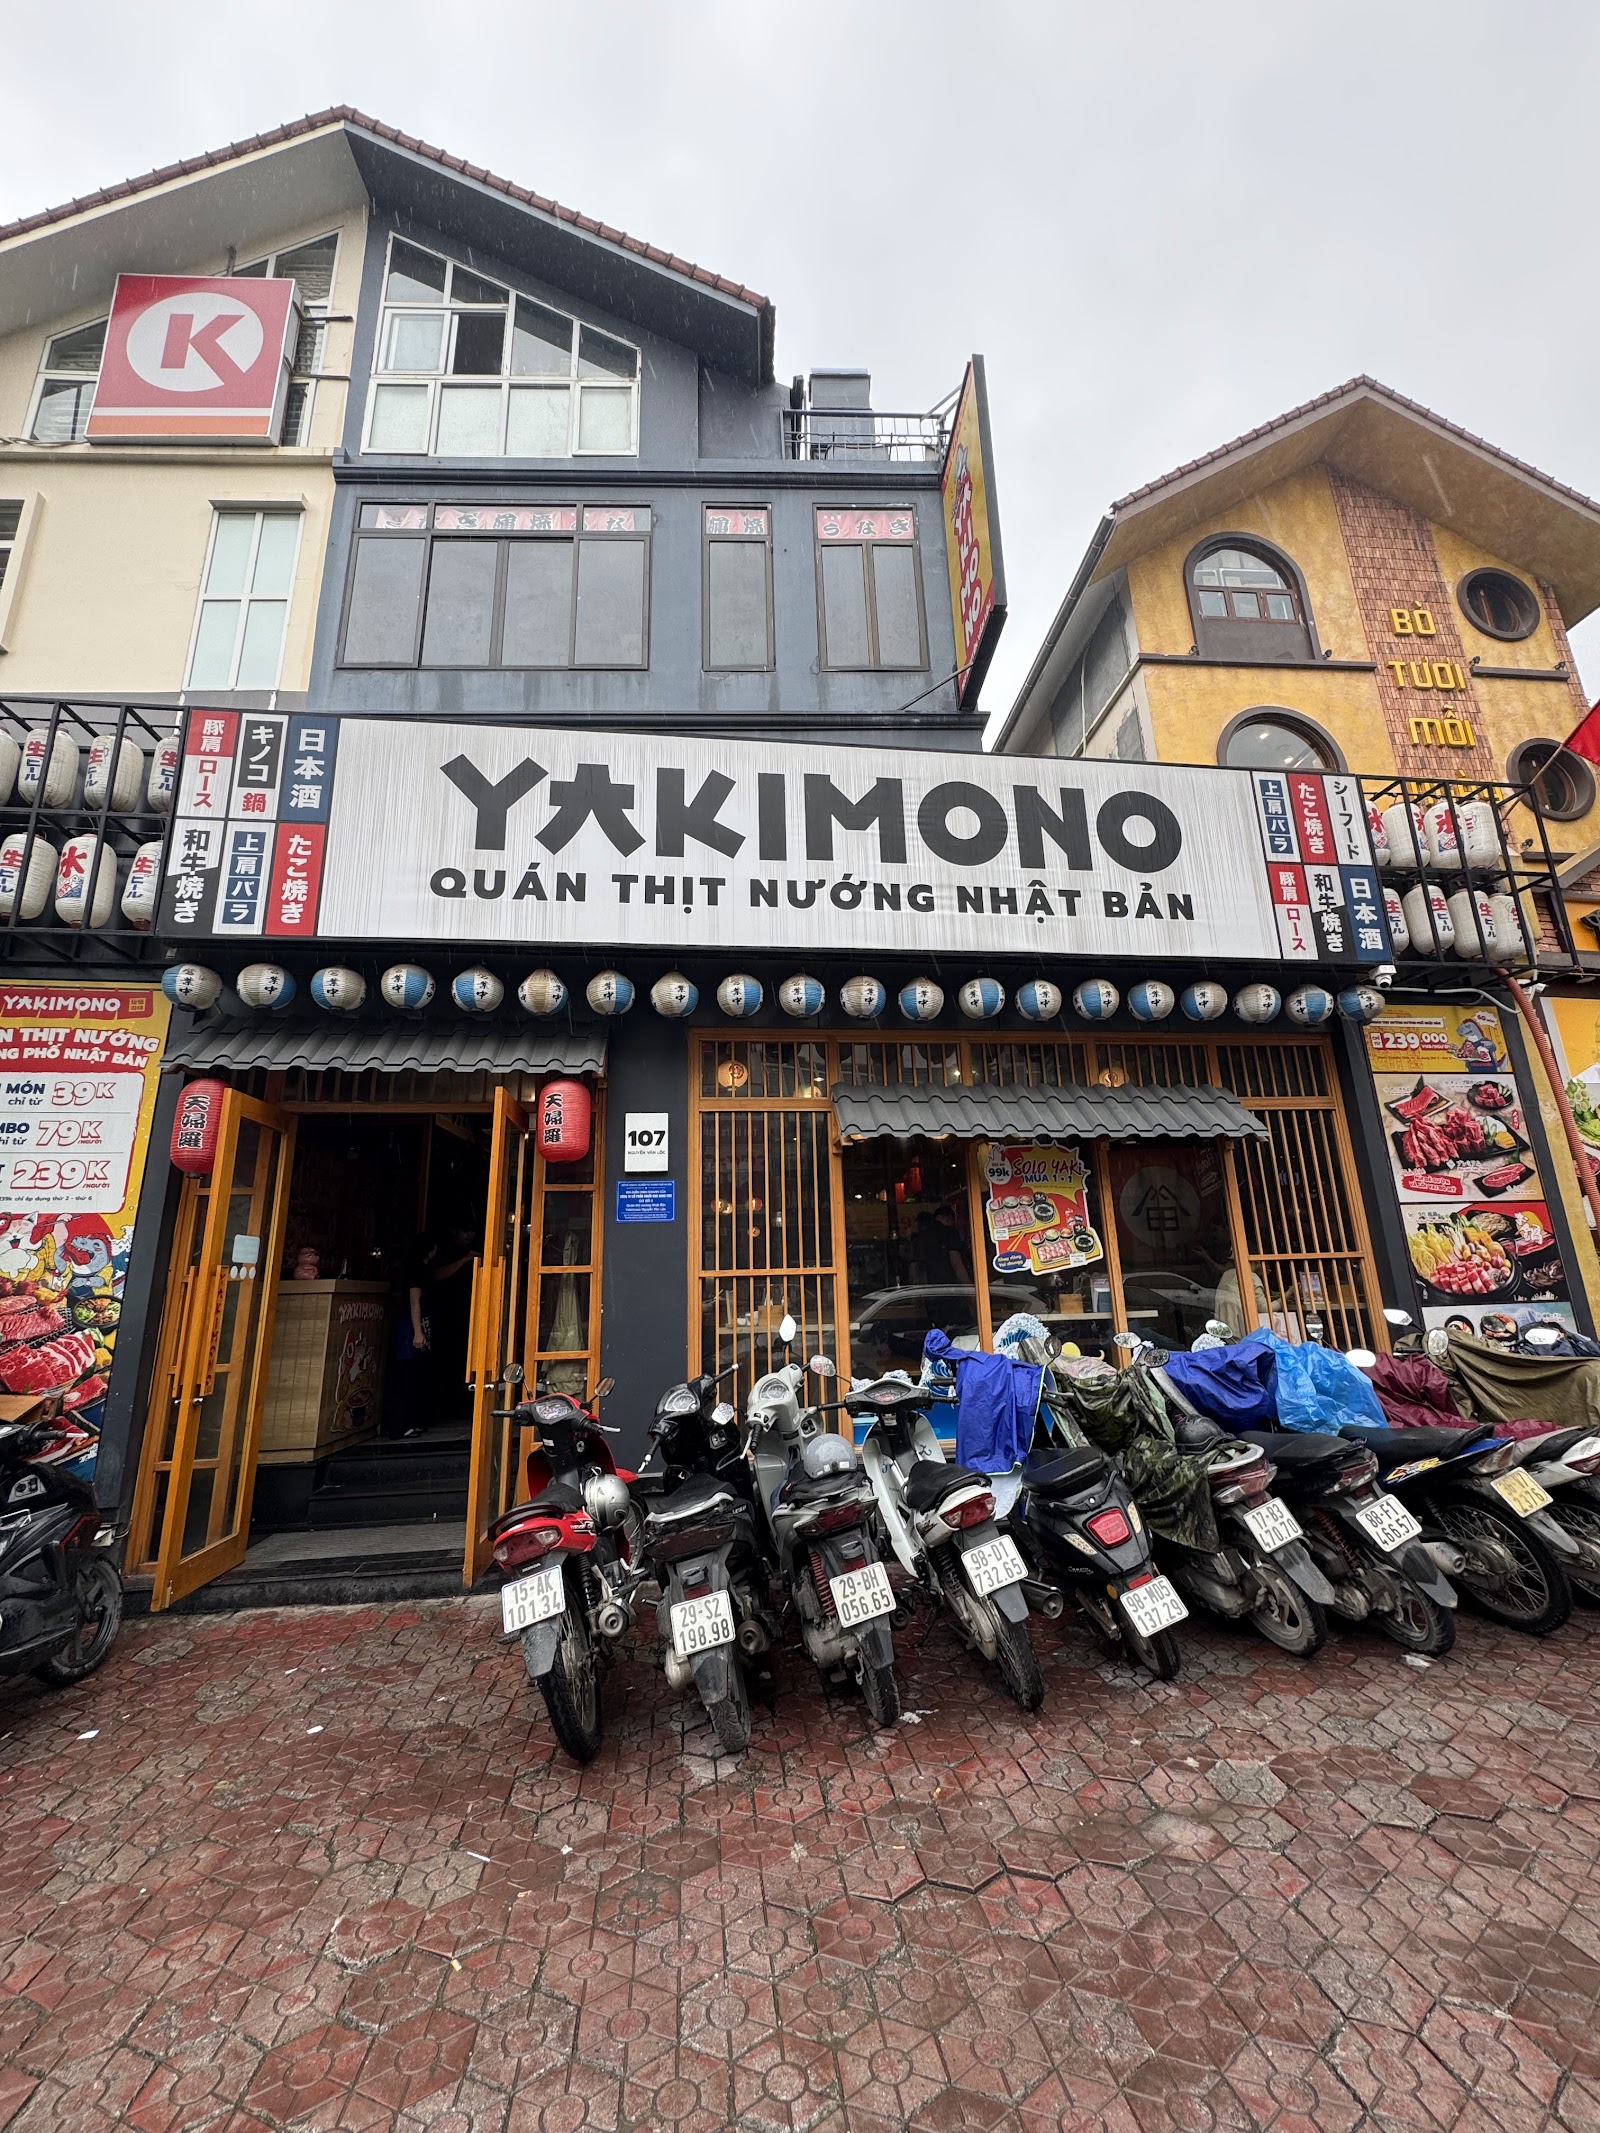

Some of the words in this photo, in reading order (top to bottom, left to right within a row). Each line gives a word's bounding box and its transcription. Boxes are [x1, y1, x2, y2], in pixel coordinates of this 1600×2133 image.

[160, 313, 245, 384] K
[1390, 600, 1436, 636] BÒ
[1387, 657, 1467, 691] TƯƠI
[193, 719, 226, 809] 豚肩ロース
[242, 725, 275, 813] キノコ鍋
[289, 728, 326, 809] 日本酒
[440, 753, 1182, 873] YAKIMONO
[1264, 781, 1288, 852] 上肩バラ
[1298, 781, 1324, 855] たこ焼き
[1333, 781, 1359, 860] シーフード
[173, 828, 211, 924] 和牛焼き
[230, 833, 260, 922] 上肩バラ
[281, 834, 312, 924] たこ焼き
[430, 862, 586, 902] QUÁN
[611, 873, 726, 914] THỊT
[750, 873, 935, 912] NƯỚNG
[956, 879, 1081, 924] NHẬT
[1102, 882, 1194, 921] BẢN
[1278, 871, 1307, 951] 豚肩ロース
[1313, 873, 1343, 952] 和牛焼き
[1349, 877, 1384, 950] 日本酒
[4, 994, 120, 1012] YAKIMONO
[19, 1027, 71, 1046] THỊT
[74, 1029, 160, 1053] NƯỚNG
[23, 1043, 60, 1059] PHỐ
[63, 1047, 109, 1064] NHẬT
[112, 1052, 148, 1069] BẢN
[6, 1080, 45, 1095] MÓN
[52, 1081, 116, 1106] 39K
[36, 1120, 102, 1147] 79K
[628, 1130, 666, 1147] 107
[10, 1159, 111, 1190] 239K
[988, 1167, 1010, 1177] 99k
[1013, 1159, 1047, 1176] SOLO
[1024, 1174, 1049, 1183] MUA
[1252, 1503, 1284, 1529] 17-B3
[1365, 1501, 1399, 1528] 88-F1
[1375, 1514, 1415, 1546] 466.57
[1259, 1518, 1299, 1549] 470.70
[970, 1541, 1010, 1570] 98-D1
[512, 1572, 553, 1604] 15-AK
[839, 1568, 880, 1599] 29-BH
[974, 1557, 1023, 1592] 732.65
[508, 1591, 561, 1627] 101.34
[680, 1597, 722, 1628] 29-S2
[840, 1588, 891, 1622] 056.65
[1137, 1598, 1183, 1632] 137.29
[679, 1618, 730, 1651] 198.98
